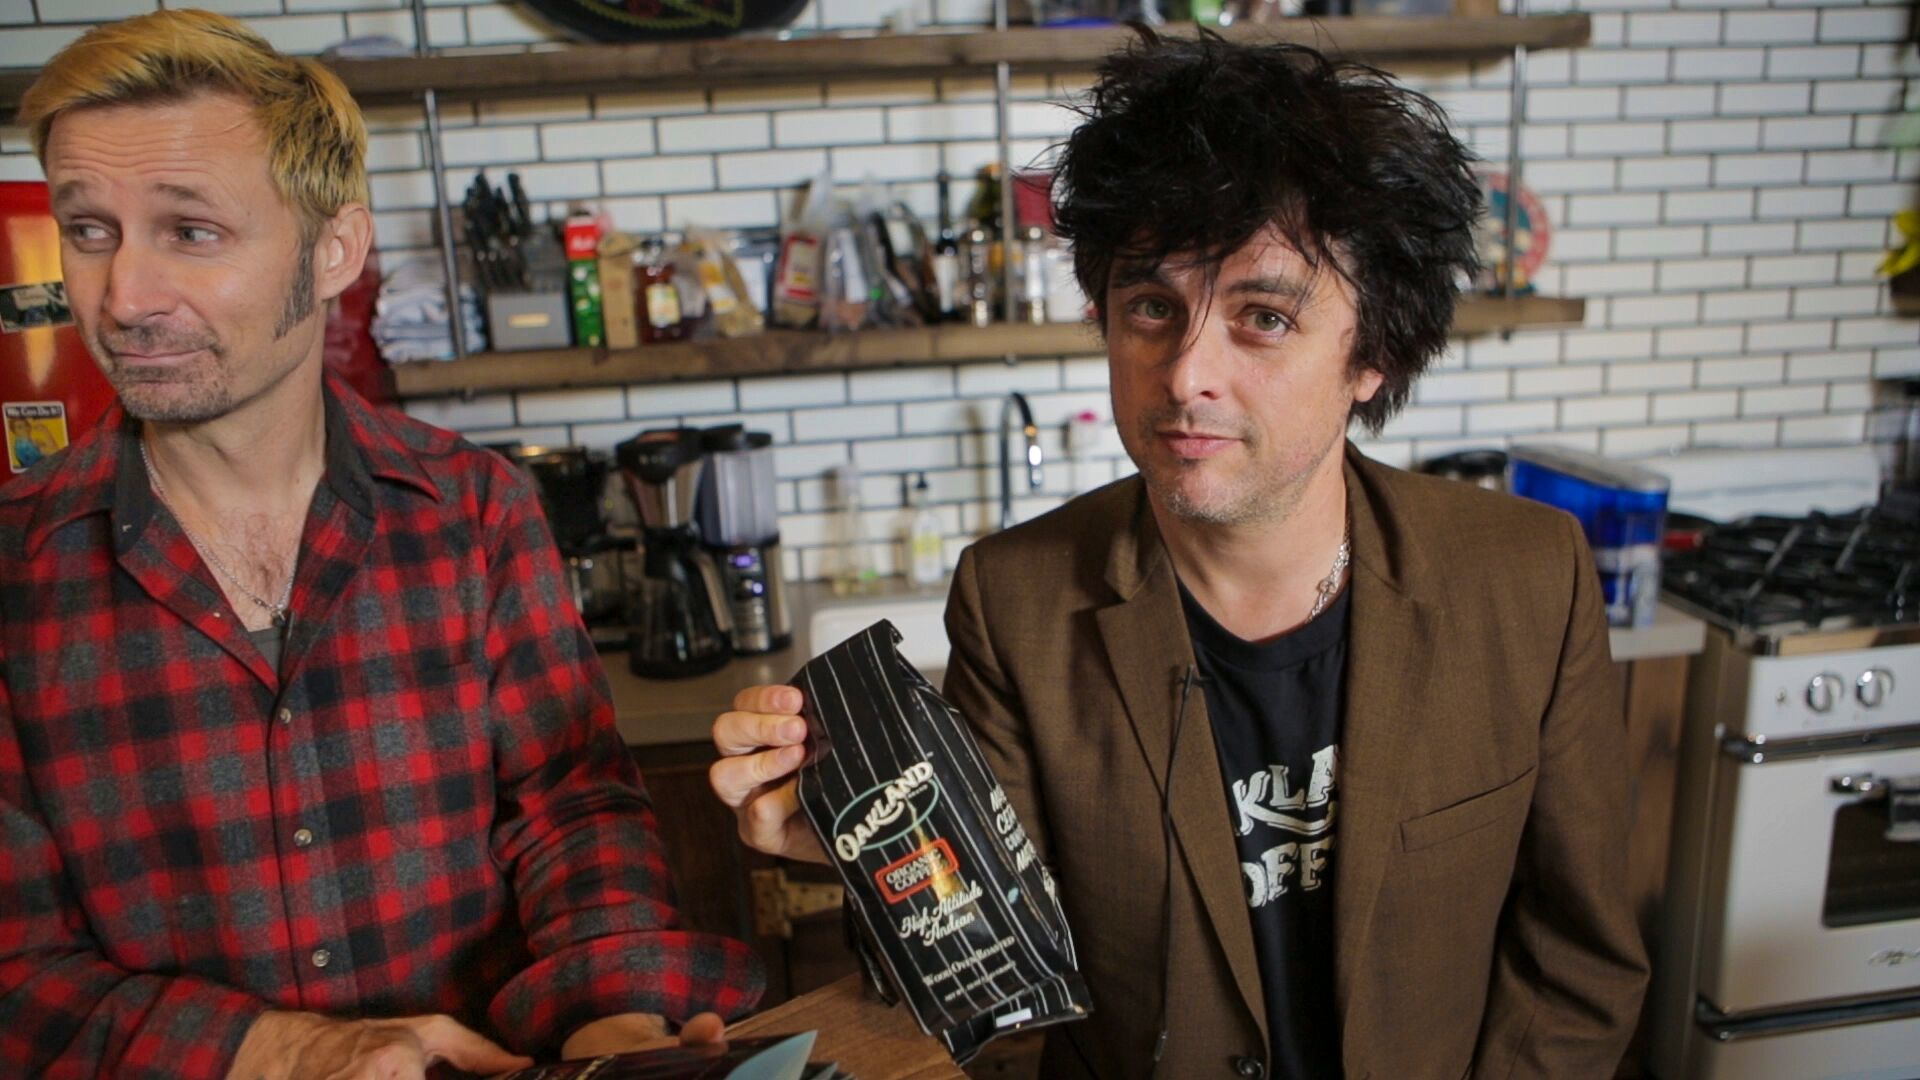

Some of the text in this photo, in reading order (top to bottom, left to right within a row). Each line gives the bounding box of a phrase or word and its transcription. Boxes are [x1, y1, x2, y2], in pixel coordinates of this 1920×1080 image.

[835, 761, 934, 862] OAKLAND
[886, 848, 941, 884] ORGANIC
[899, 906, 932, 939] High
